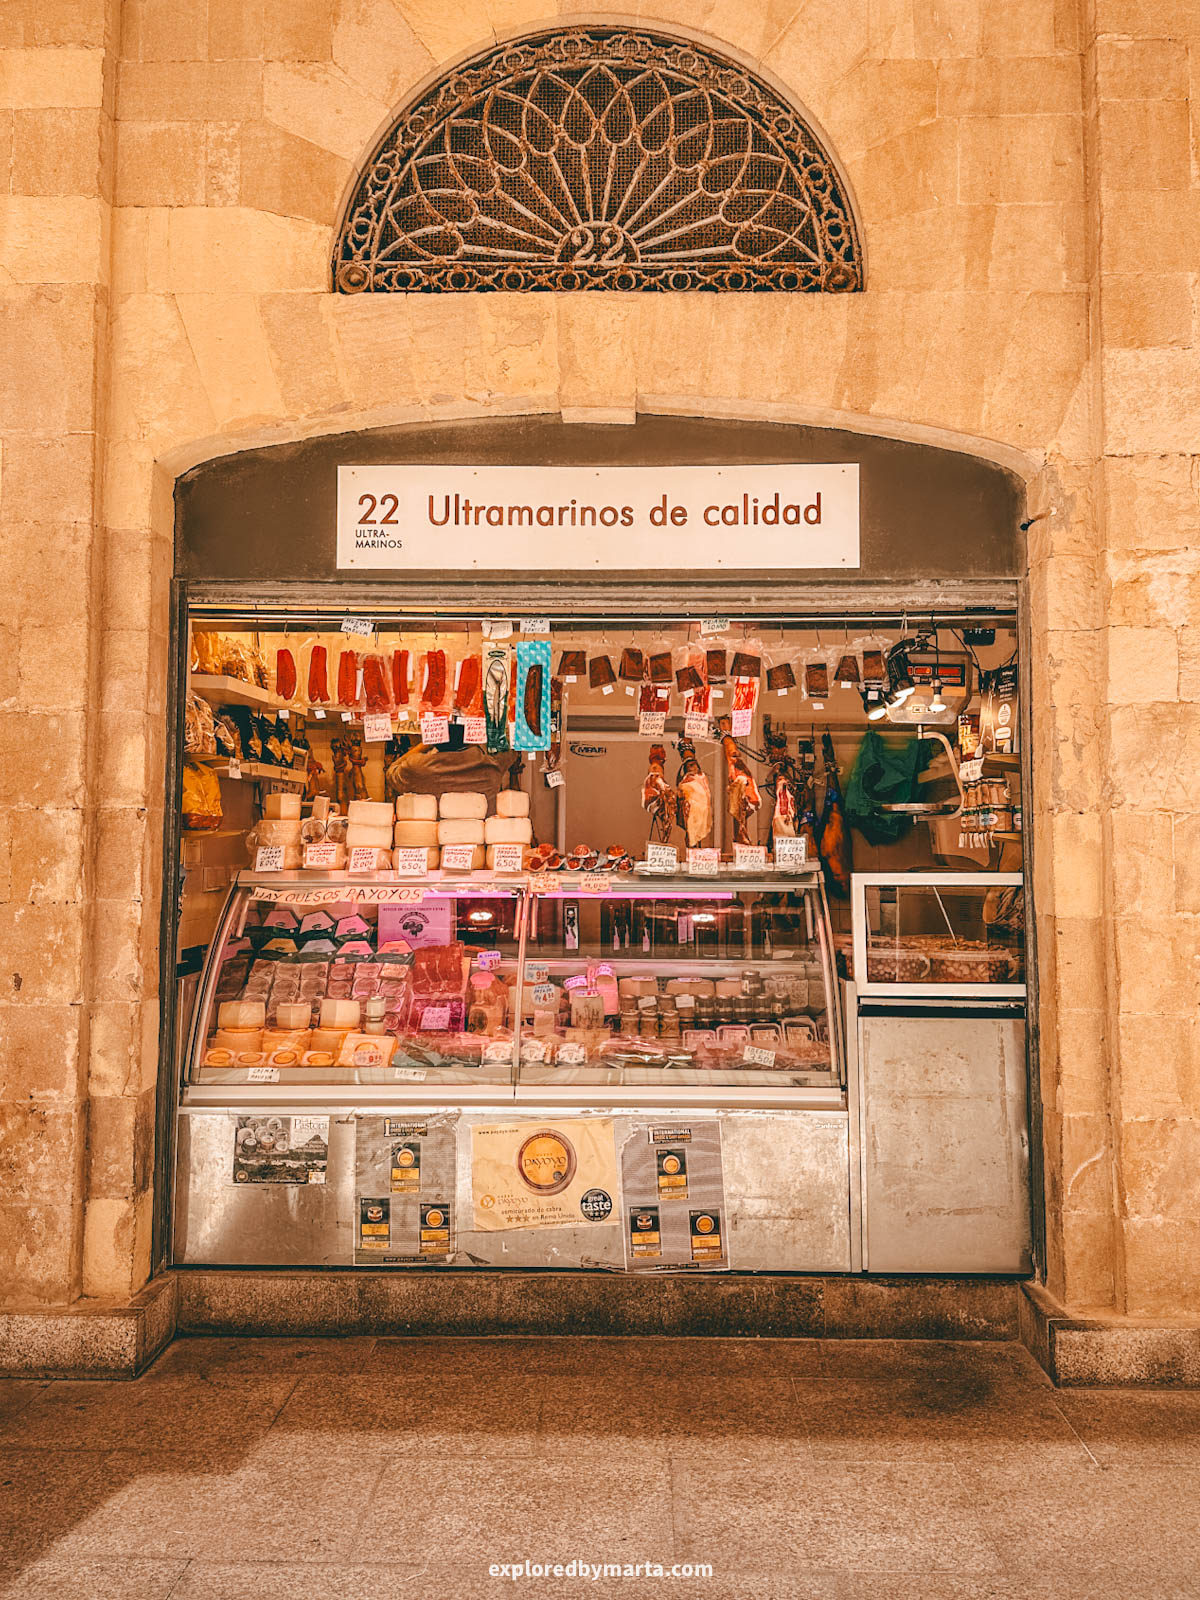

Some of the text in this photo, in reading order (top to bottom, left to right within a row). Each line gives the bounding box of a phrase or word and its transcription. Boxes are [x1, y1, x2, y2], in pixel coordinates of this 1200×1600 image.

[571, 228, 626, 267] 22
[358, 492, 822, 527] 22 Ultramarinos de calidad
[355, 529, 390, 538] ULTRA-
[355, 539, 402, 549] MARINOS
[285, 889, 341, 902] QUESOS
[346, 888, 421, 900] PAYOYOS
[582, 1201, 611, 1211] taste
